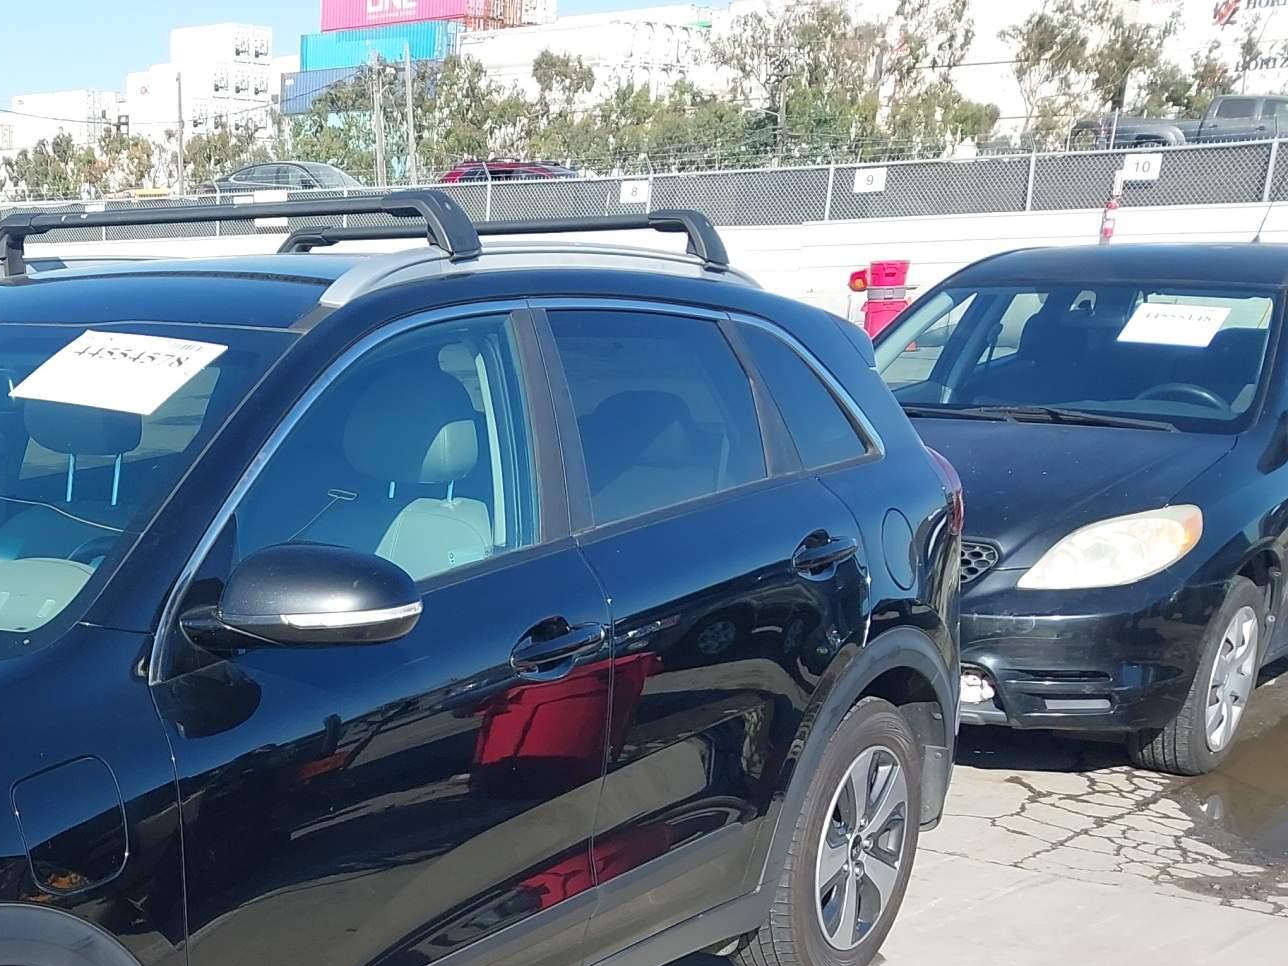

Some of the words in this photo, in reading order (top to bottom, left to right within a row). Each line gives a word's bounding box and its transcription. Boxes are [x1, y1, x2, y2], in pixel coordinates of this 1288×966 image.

[1135, 160, 1151, 173] 10
[865, 174, 874, 186] 9
[630, 186, 638, 197] 8
